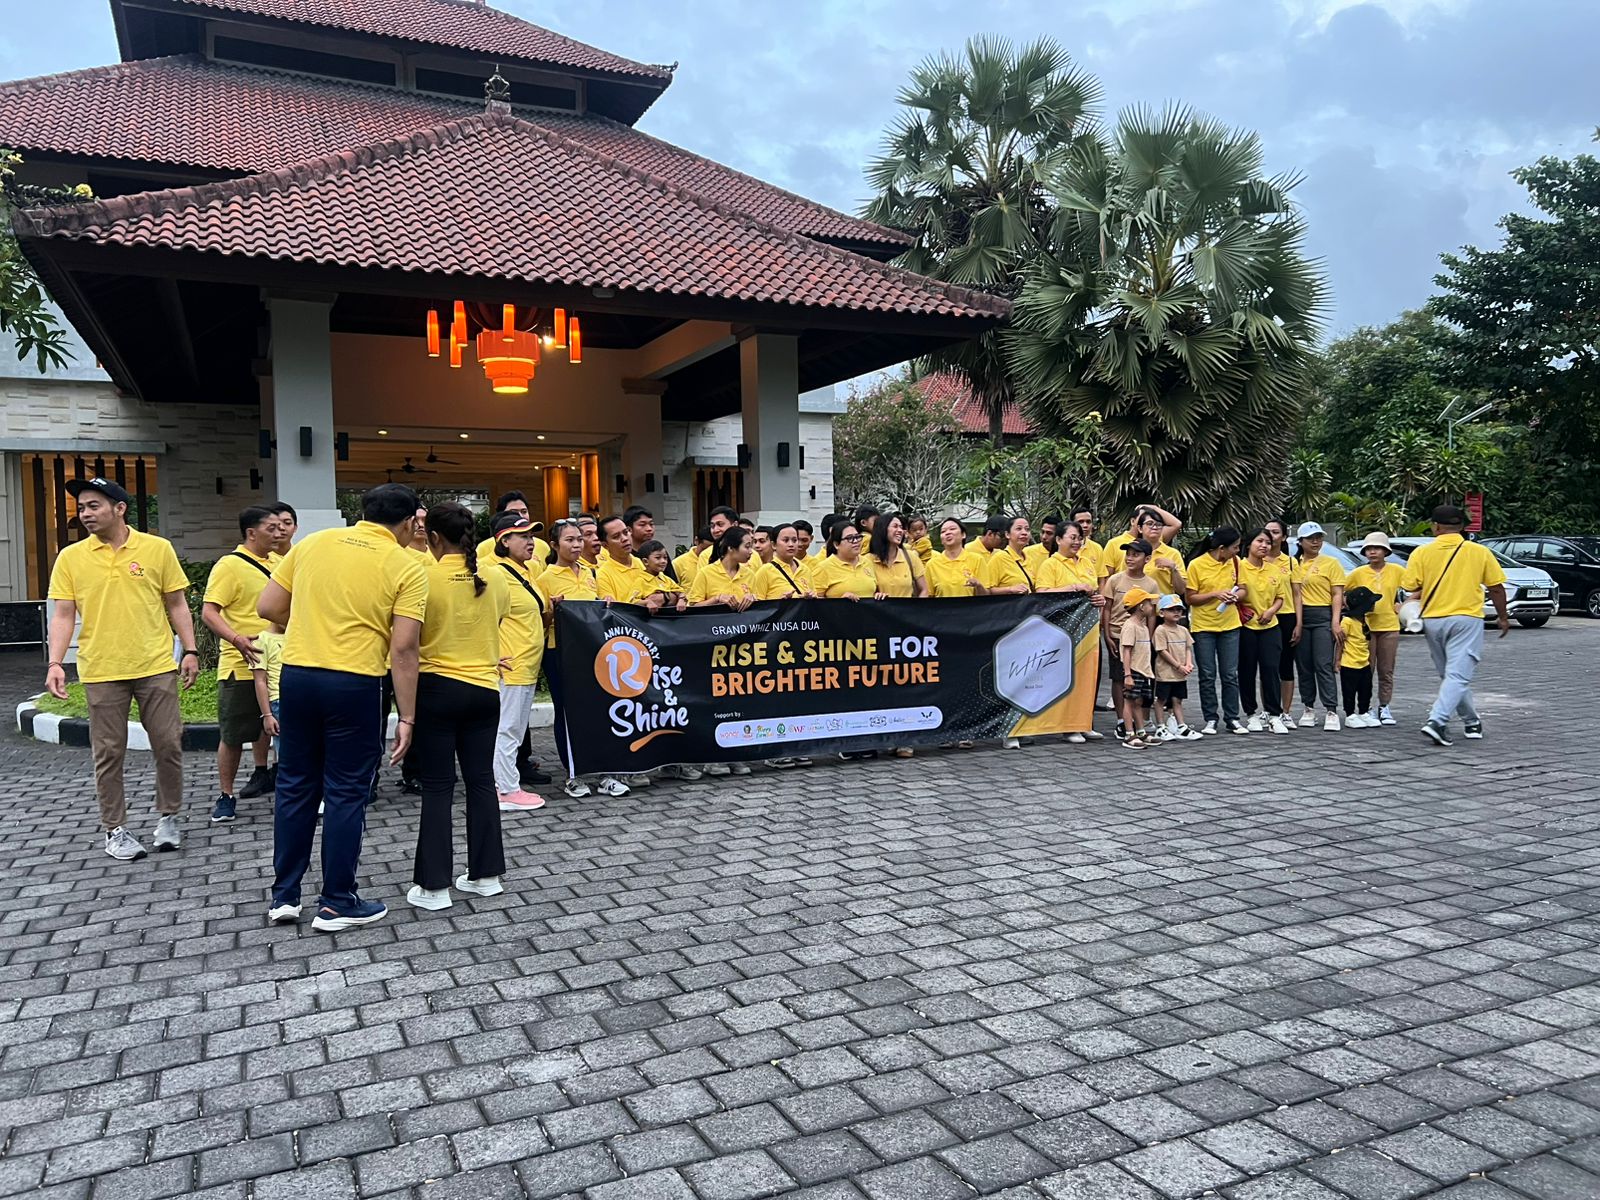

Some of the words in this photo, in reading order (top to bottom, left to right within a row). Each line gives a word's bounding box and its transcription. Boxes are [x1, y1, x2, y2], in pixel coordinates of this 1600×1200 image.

[603, 626, 661, 660] ANNIVERSARY
[711, 624, 747, 636] GRAND
[749, 623, 770, 633] WHIZ
[772, 622, 799, 632] NUSA
[801, 621, 820, 631] DUA
[711, 642, 767, 667] RISE
[777, 641, 796, 664] &
[803, 638, 878, 662] SHINE
[889, 636, 939, 659] FOR
[711, 667, 841, 697] BRIGHTER
[848, 661, 940, 688] FUTURE
[663, 688, 678, 706] &
[608, 698, 689, 737] Shine
